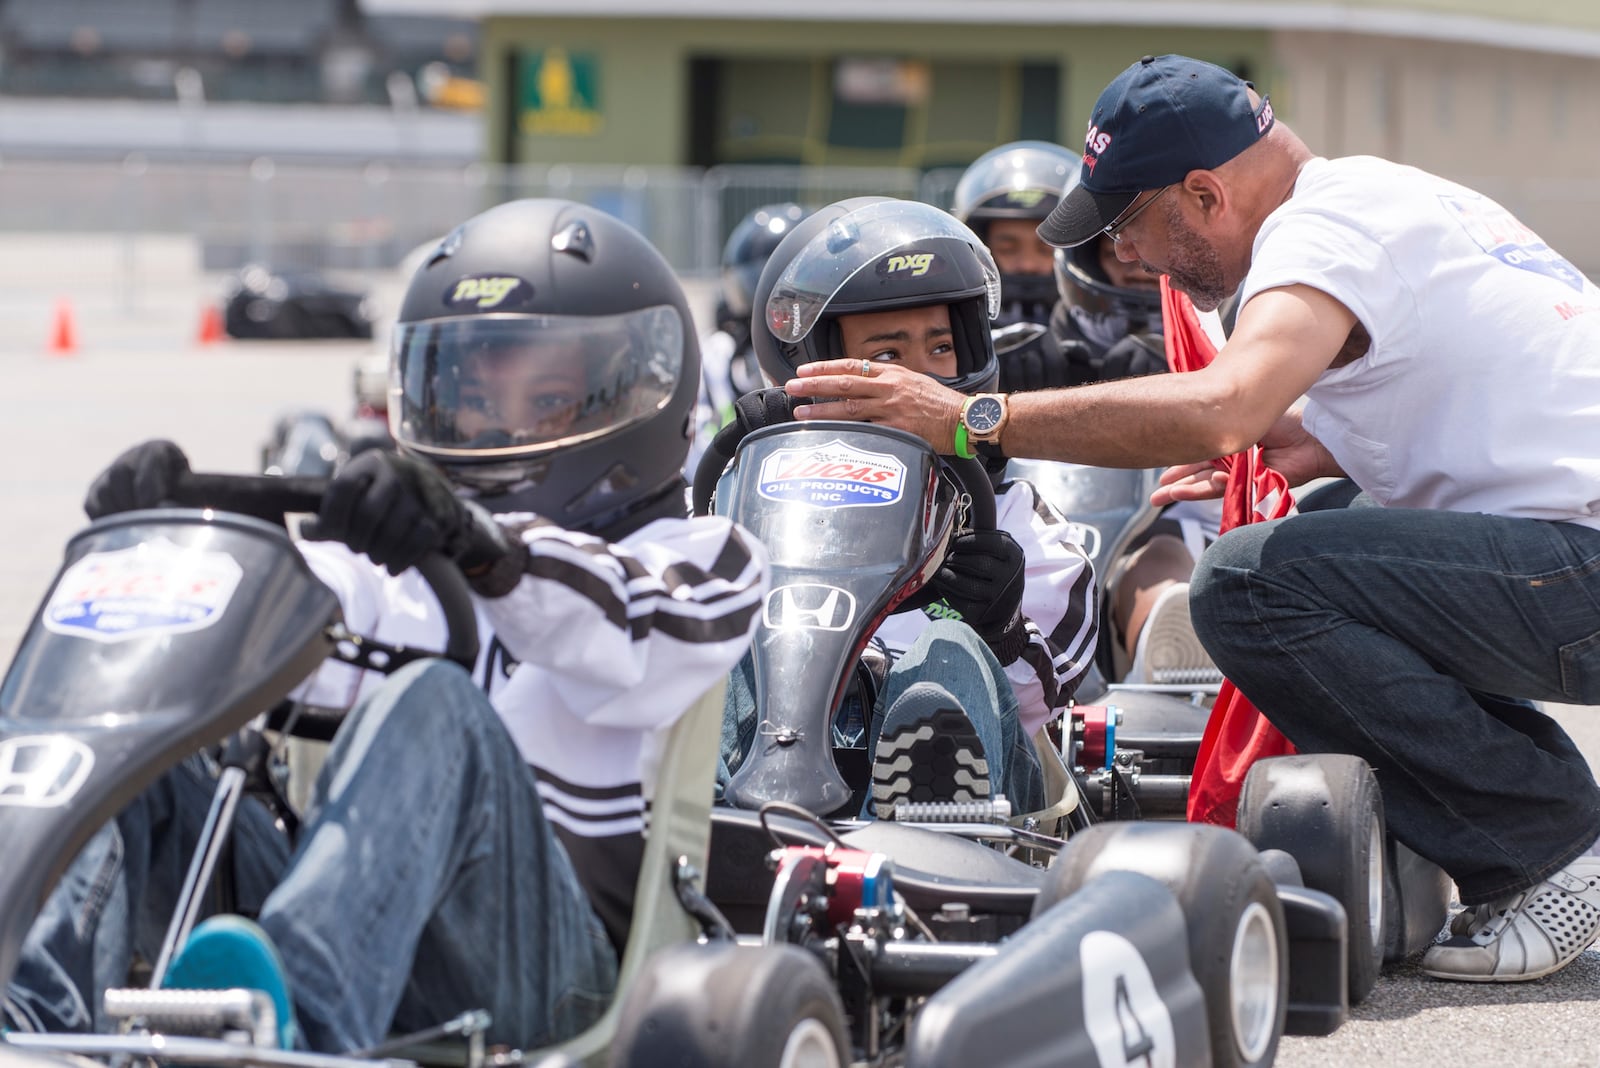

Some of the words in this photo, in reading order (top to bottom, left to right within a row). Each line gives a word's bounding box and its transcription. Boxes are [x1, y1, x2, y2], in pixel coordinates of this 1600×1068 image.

[887, 253, 936, 277] nxg
[776, 462, 896, 483] LUCAS
[766, 481, 794, 493] OIL
[800, 481, 893, 500] PRODUCTS
[810, 492, 846, 502] INC.
[1114, 974, 1155, 1068] 4
